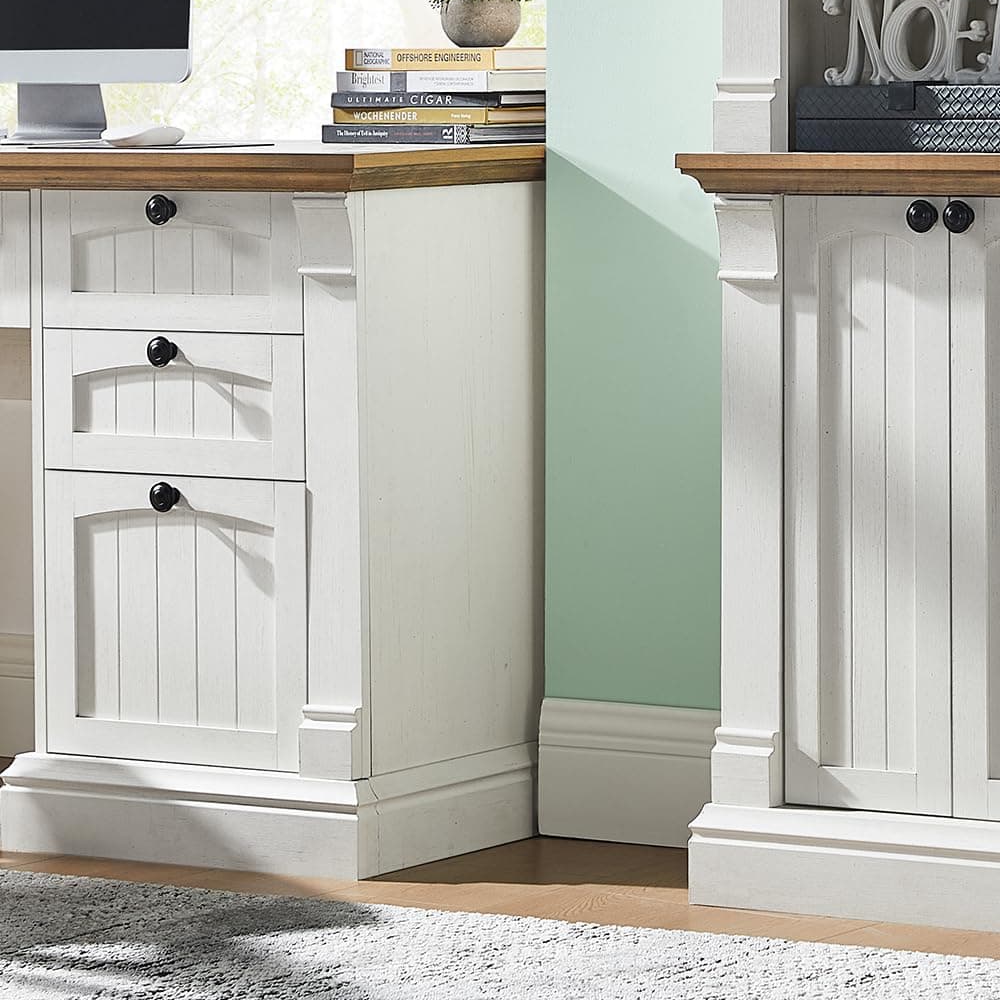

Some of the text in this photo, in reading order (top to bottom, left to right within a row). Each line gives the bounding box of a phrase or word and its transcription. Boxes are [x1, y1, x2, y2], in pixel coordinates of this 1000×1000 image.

[363, 51, 481, 62] NATIONAL OFFSHORE ENGINEERING
[351, 72, 385, 88] Brightest
[410, 95, 453, 105] CIGAR
[353, 111, 418, 121] WOCHENENDER
